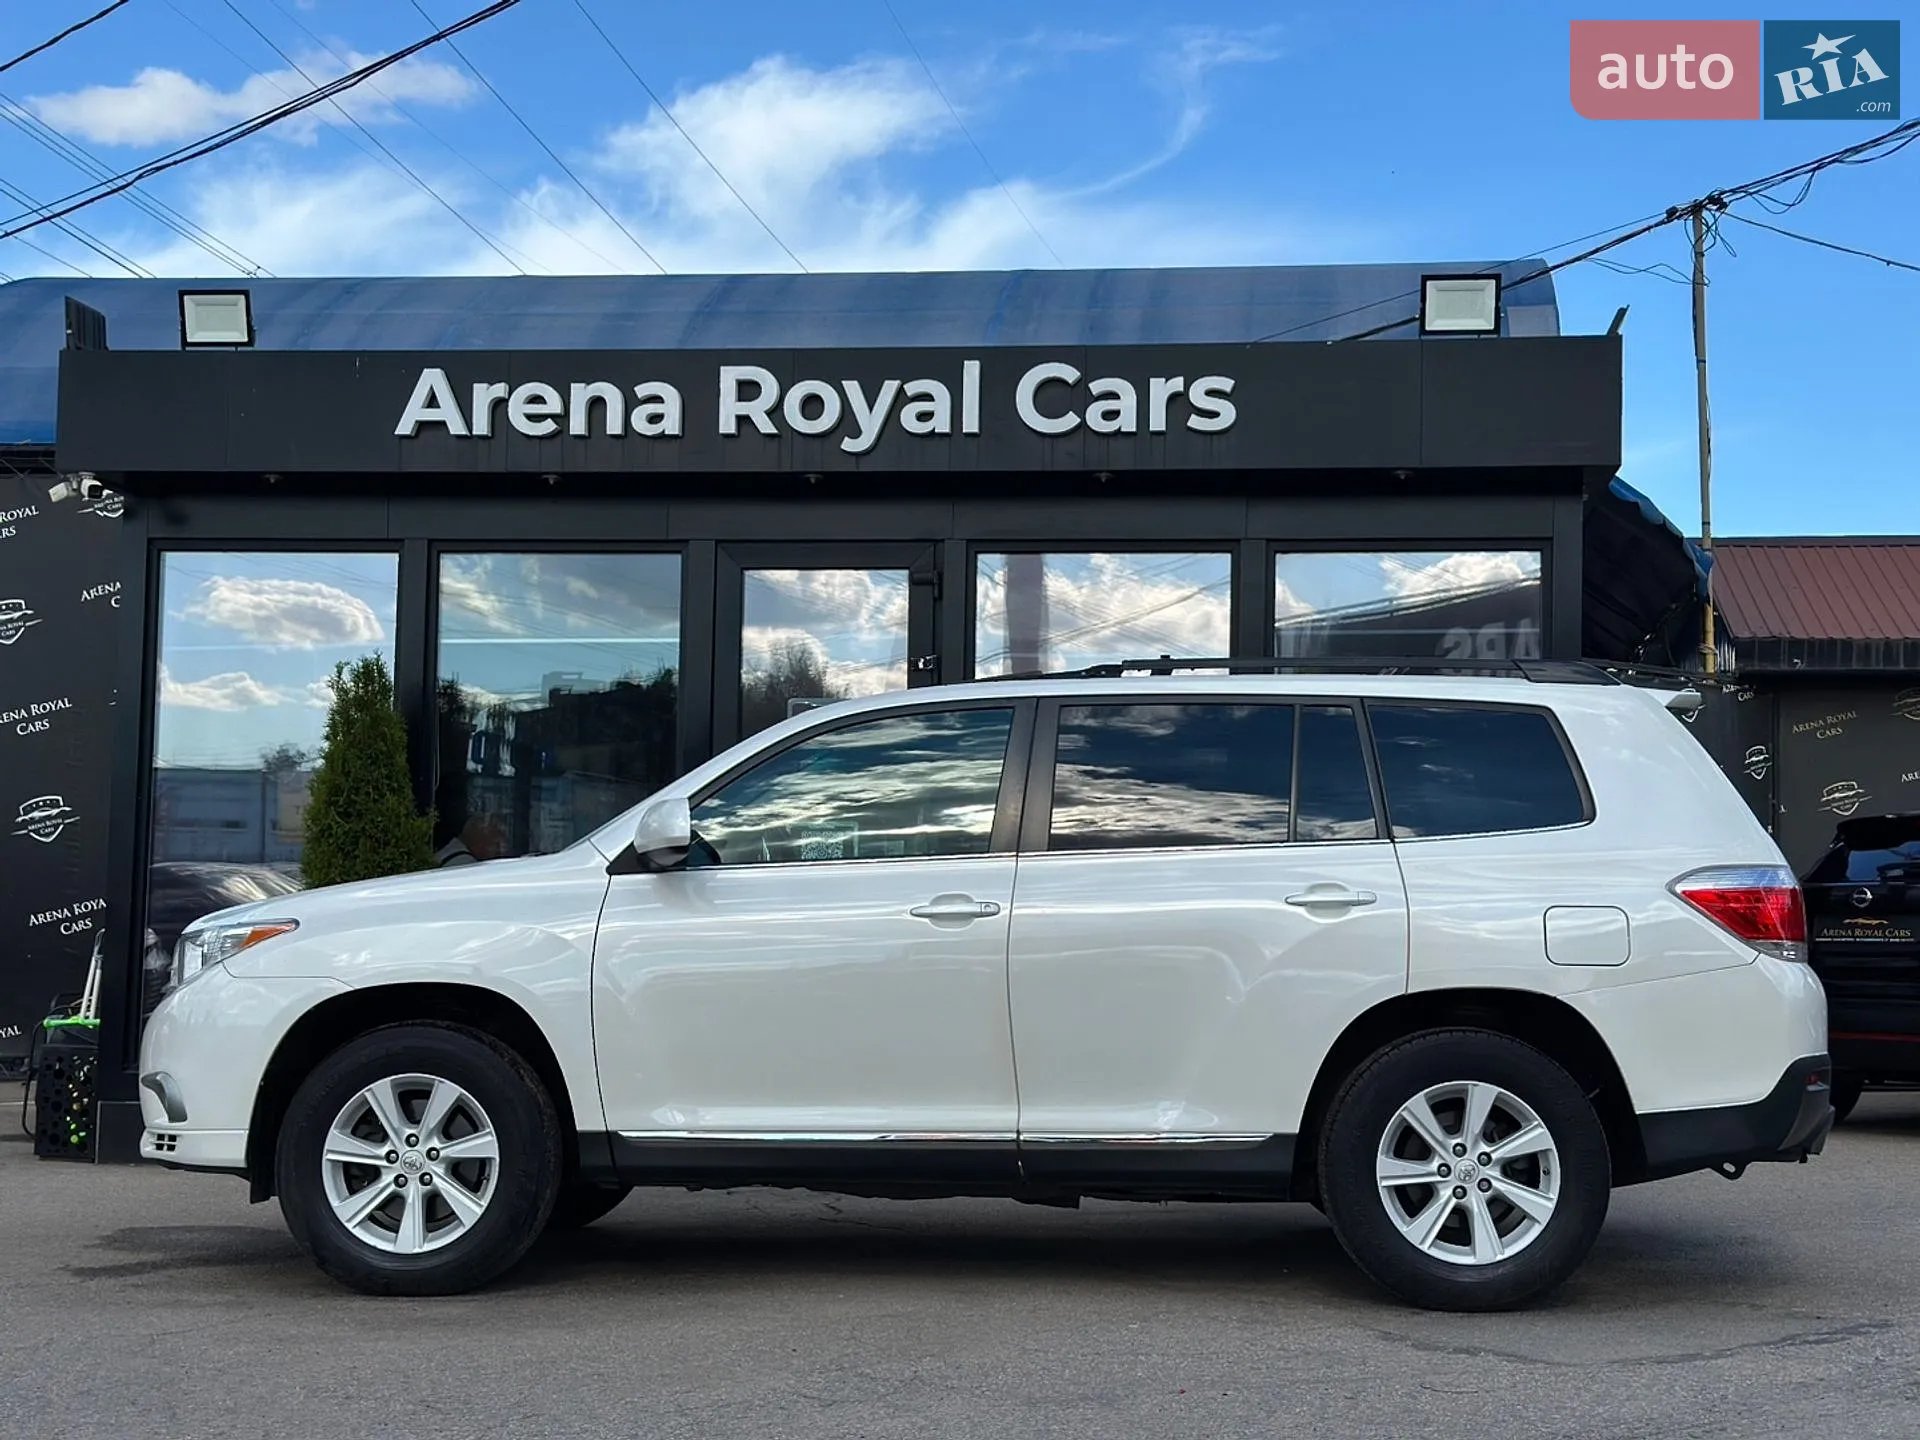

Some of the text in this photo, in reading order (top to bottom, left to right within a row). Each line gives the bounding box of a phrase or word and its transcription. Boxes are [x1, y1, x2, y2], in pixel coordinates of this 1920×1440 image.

[395, 359, 1238, 455] Arena Royal Cars
[0, 526, 16, 540] RS
[81, 581, 121, 602] ARENA
[30, 697, 72, 716] ROYAL
[16, 718, 50, 736] CARS
[1792, 710, 1858, 734] ARENA ROYAL
[1816, 727, 1844, 740] CARS
[29, 907, 72, 927] ARENA
[60, 918, 93, 936] CARS
[1821, 927, 1912, 937] ARENA ROYAL CARS
